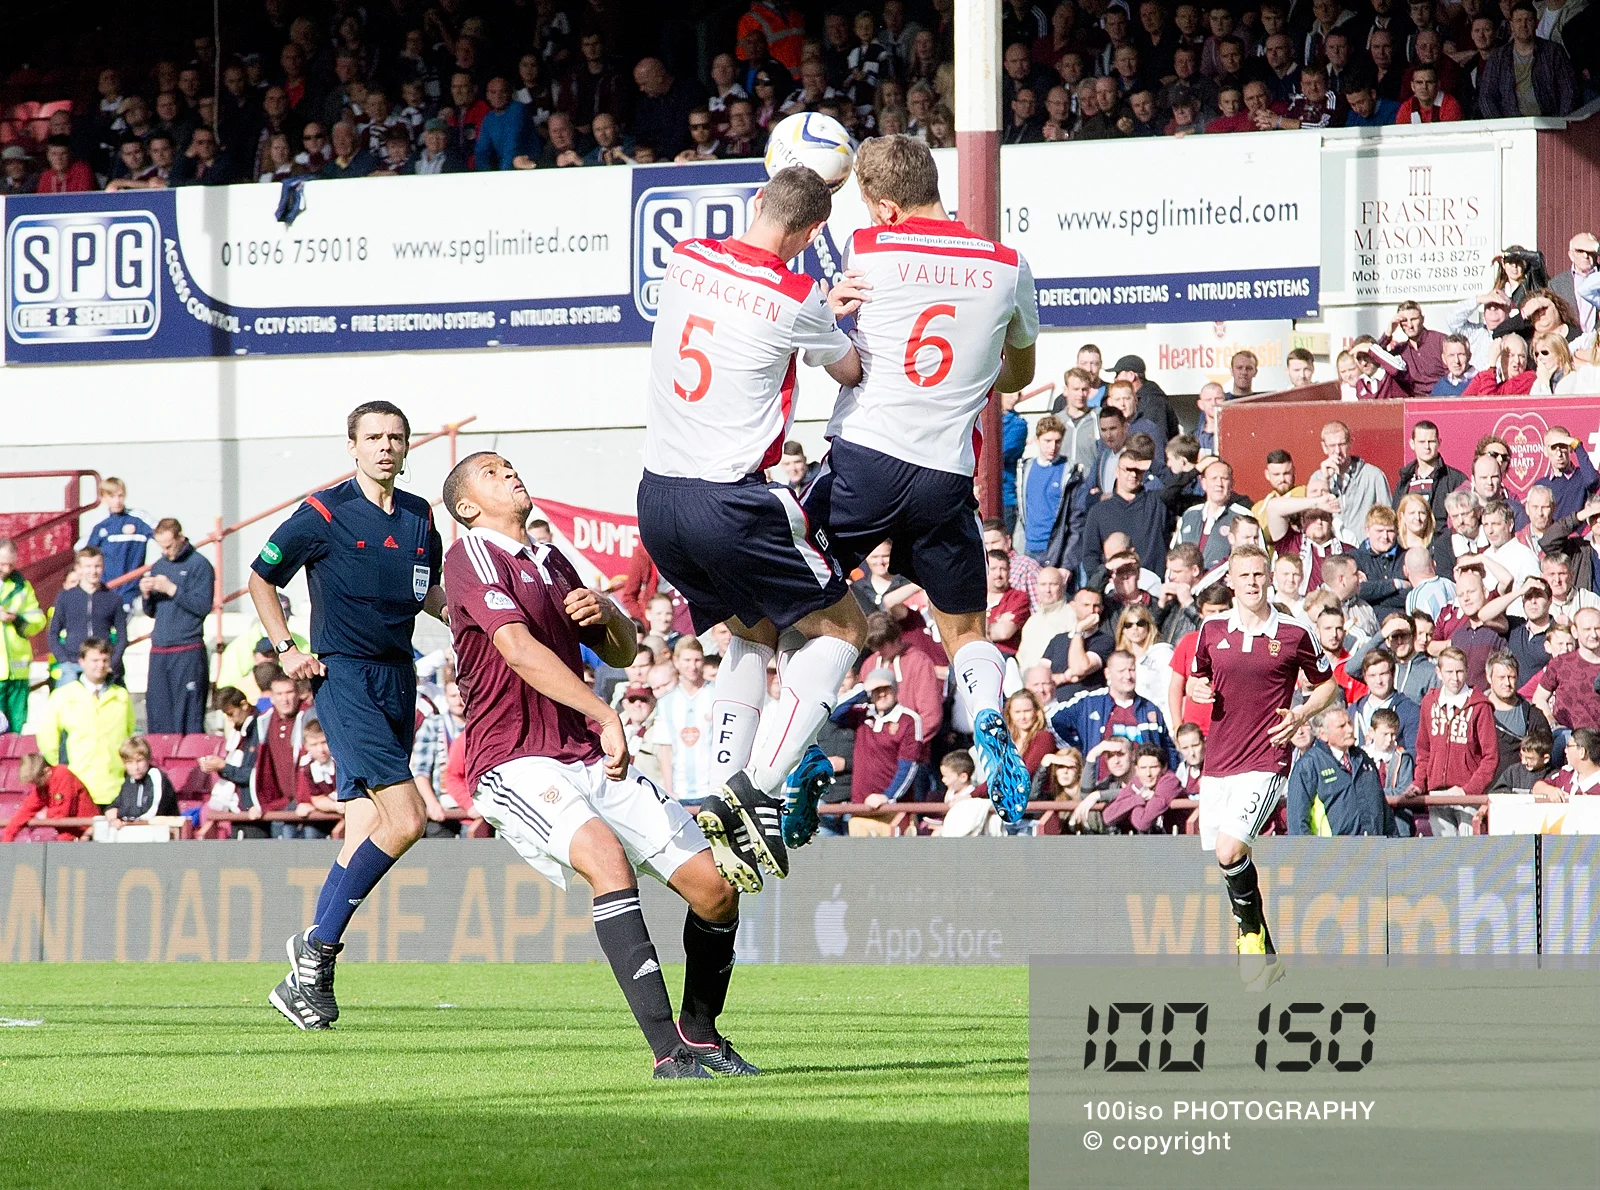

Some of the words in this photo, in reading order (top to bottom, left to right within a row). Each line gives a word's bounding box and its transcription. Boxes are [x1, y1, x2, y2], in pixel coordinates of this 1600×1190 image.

[1057, 196, 1299, 236] www.spglimited.com
[1361, 196, 1479, 224] FRASER'S
[221, 239, 284, 266] 01896
[293, 236, 368, 264] 759018
[393, 227, 609, 264] www.spglimited.com
[895, 235, 994, 250] webhelpukcareers.com
[1354, 224, 1469, 250] MASONRY
[23, 229, 143, 294] SPG
[1386, 253, 1414, 265] 0131
[1420, 252, 1445, 263] 443
[1450, 250, 1480, 262] 8275
[163, 238, 191, 303] ACCESS
[186, 297, 241, 333] CONTROL
[254, 317, 286, 335] CCTV
[286, 315, 337, 333] SYSTEMS
[351, 315, 376, 332] FIRE
[377, 312, 443, 332] DETECTION
[444, 311, 496, 330] SYSTEMS
[510, 307, 569, 327] INTRUDER
[569, 305, 622, 325] SYSTEMS
[898, 262, 993, 289] VAULKS
[1390, 268, 1421, 280] 0786
[1427, 267, 1458, 279] 7888
[1463, 266, 1486, 277] 987
[1039, 286, 1114, 307] DETECTION
[1113, 284, 1169, 305] SYSTEMS
[1187, 281, 1252, 302] INTRUDER
[1253, 278, 1310, 299] SYSTEMS
[20, 307, 51, 328] FIRE
[75, 304, 146, 326] SECURITY
[904, 304, 957, 387] 6
[1293, 335, 1315, 350] EXIT
[673, 313, 717, 402] 5
[717, 712, 737, 764] FFC
[1431, 718, 1468, 738] STER
[1243, 792, 1261, 814] 3
[865, 916, 923, 964] App
[929, 916, 1003, 959] Store
